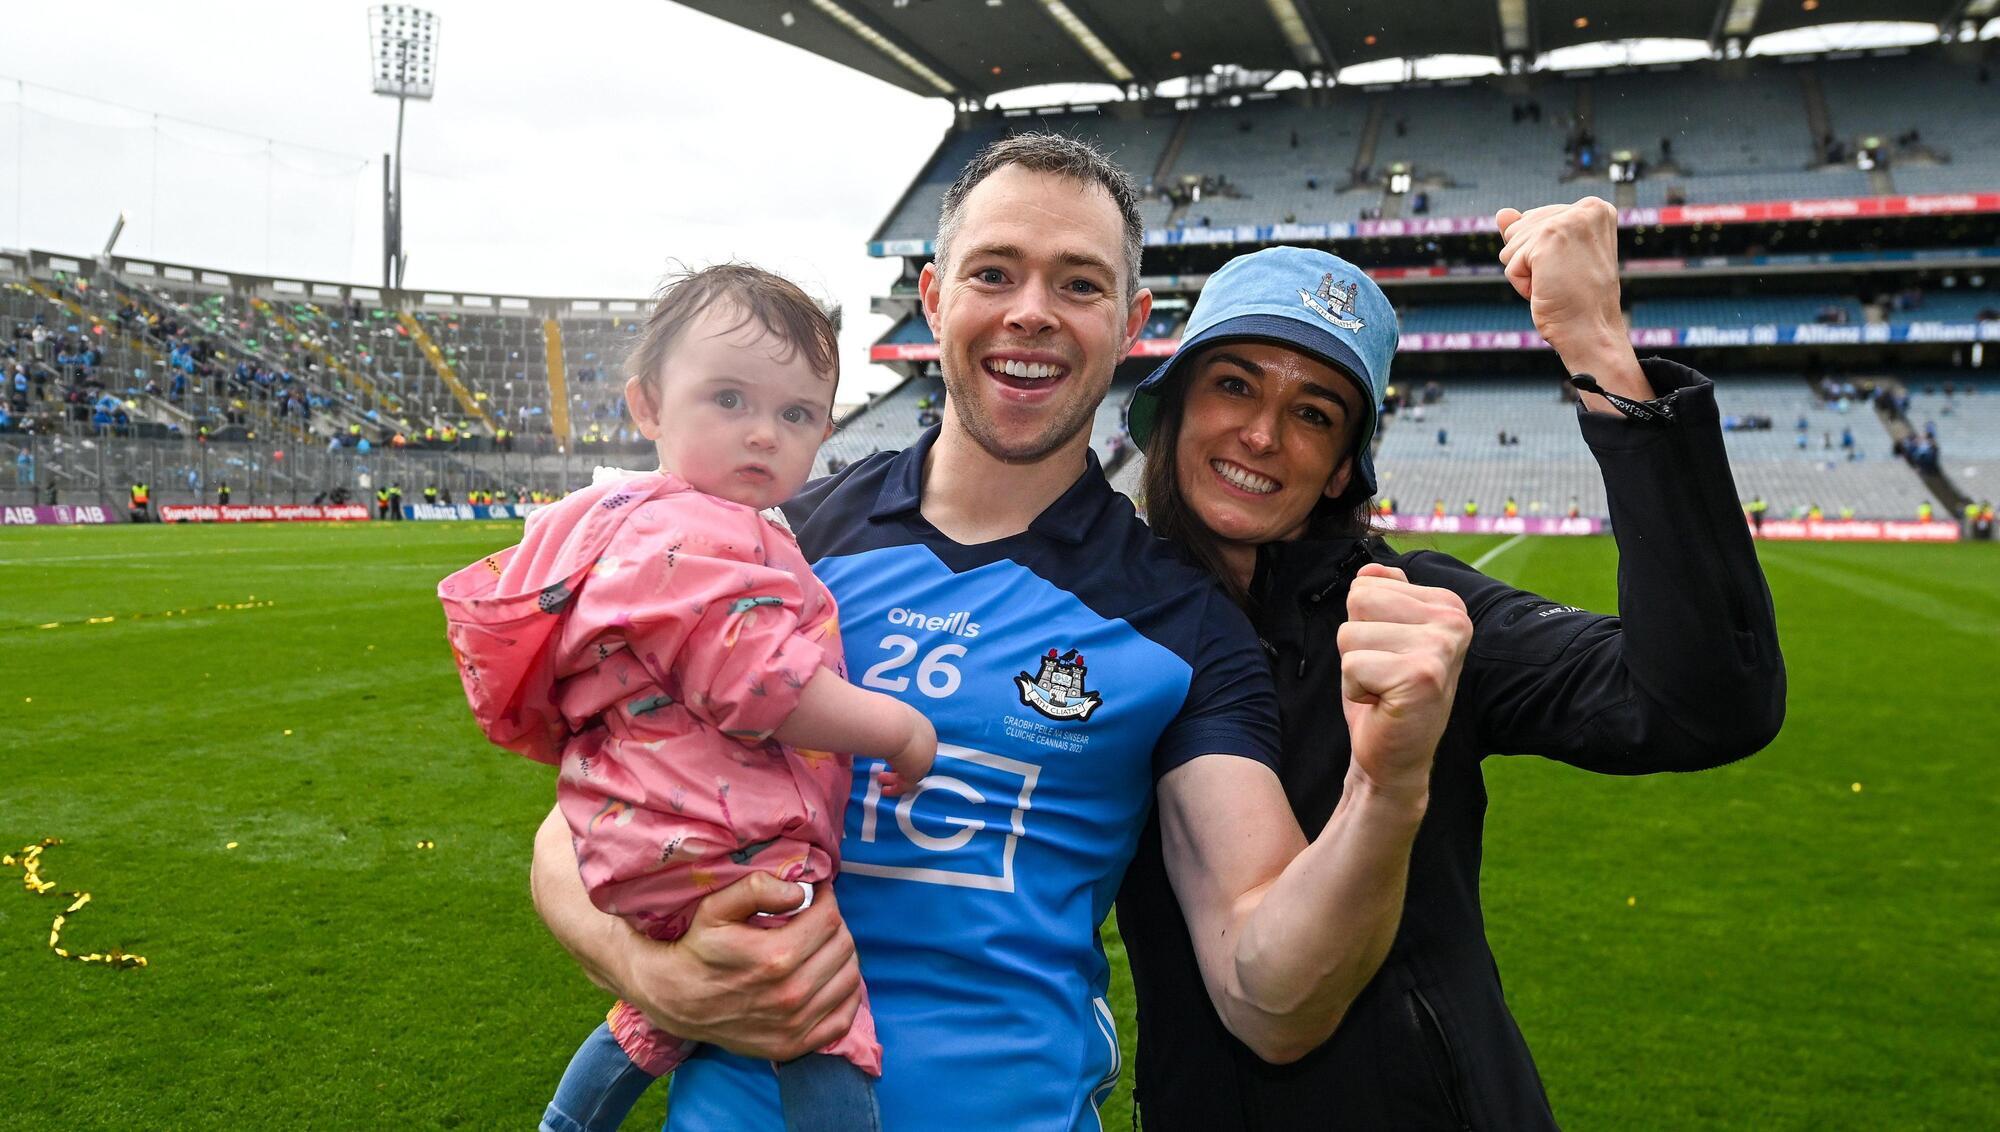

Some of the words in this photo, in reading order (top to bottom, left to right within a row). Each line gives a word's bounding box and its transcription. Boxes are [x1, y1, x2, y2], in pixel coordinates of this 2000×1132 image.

[4, 506, 37, 524] AIB
[75, 506, 105, 523] AIB
[413, 504, 458, 520] Allianz
[861, 634, 968, 699] 26
[1003, 715, 1034, 731] CRAOBH
[1034, 722, 1053, 735] PEILE
[1054, 728, 1062, 737] NA
[1063, 730, 1090, 744] SINSEAR
[1005, 727, 1035, 742] CLUICHE
[1035, 733, 1069, 750] CEANNAIS
[1069, 743, 1083, 753] 2023
[843, 763, 986, 851] IG
